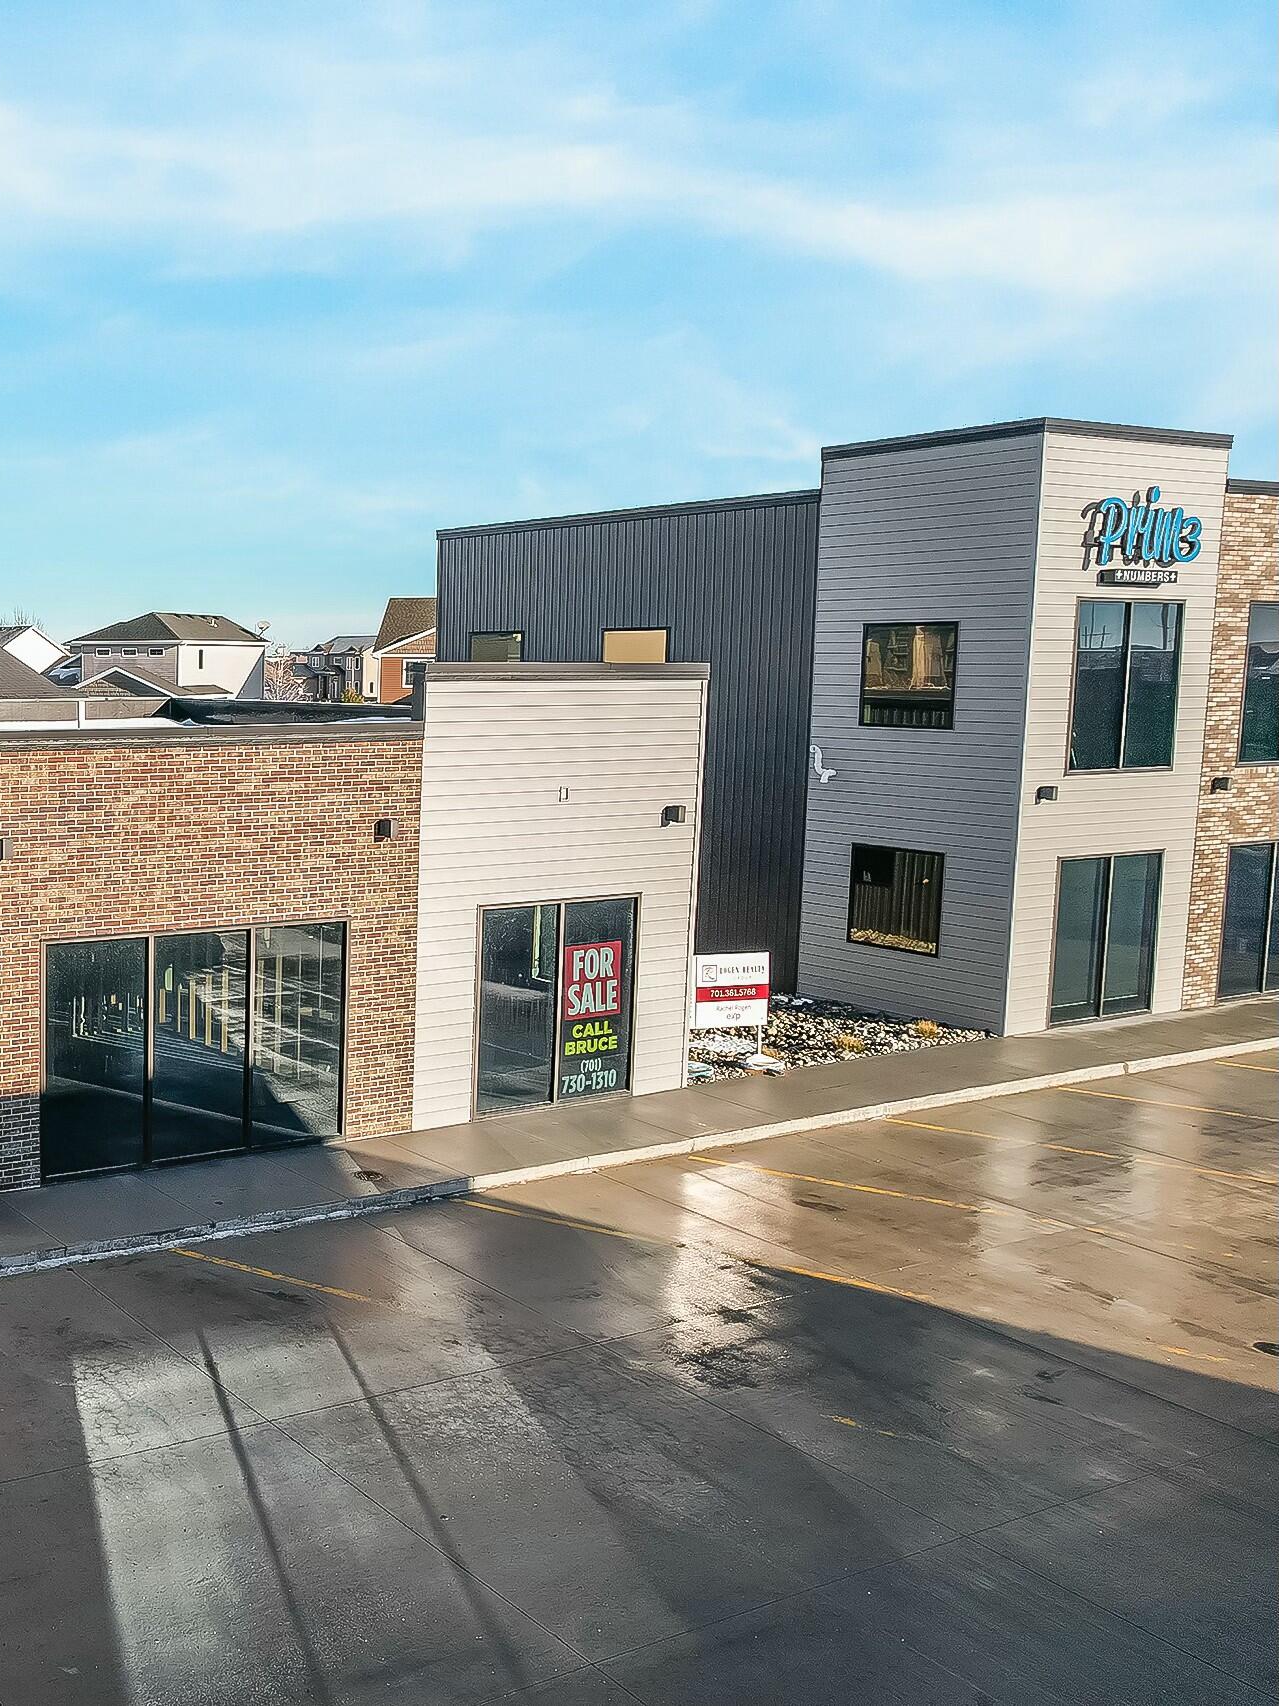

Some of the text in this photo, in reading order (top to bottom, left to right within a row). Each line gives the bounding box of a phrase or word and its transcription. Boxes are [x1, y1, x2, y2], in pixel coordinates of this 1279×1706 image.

[1122, 570, 1170, 582] NUMBERS
[573, 947, 614, 981] FOR
[567, 979, 618, 1016] SALE
[572, 1020, 613, 1039] CALL
[564, 1035, 618, 1056] BRUCE
[580, 1057, 602, 1074] (701)
[561, 1069, 617, 1094] 730-1310
